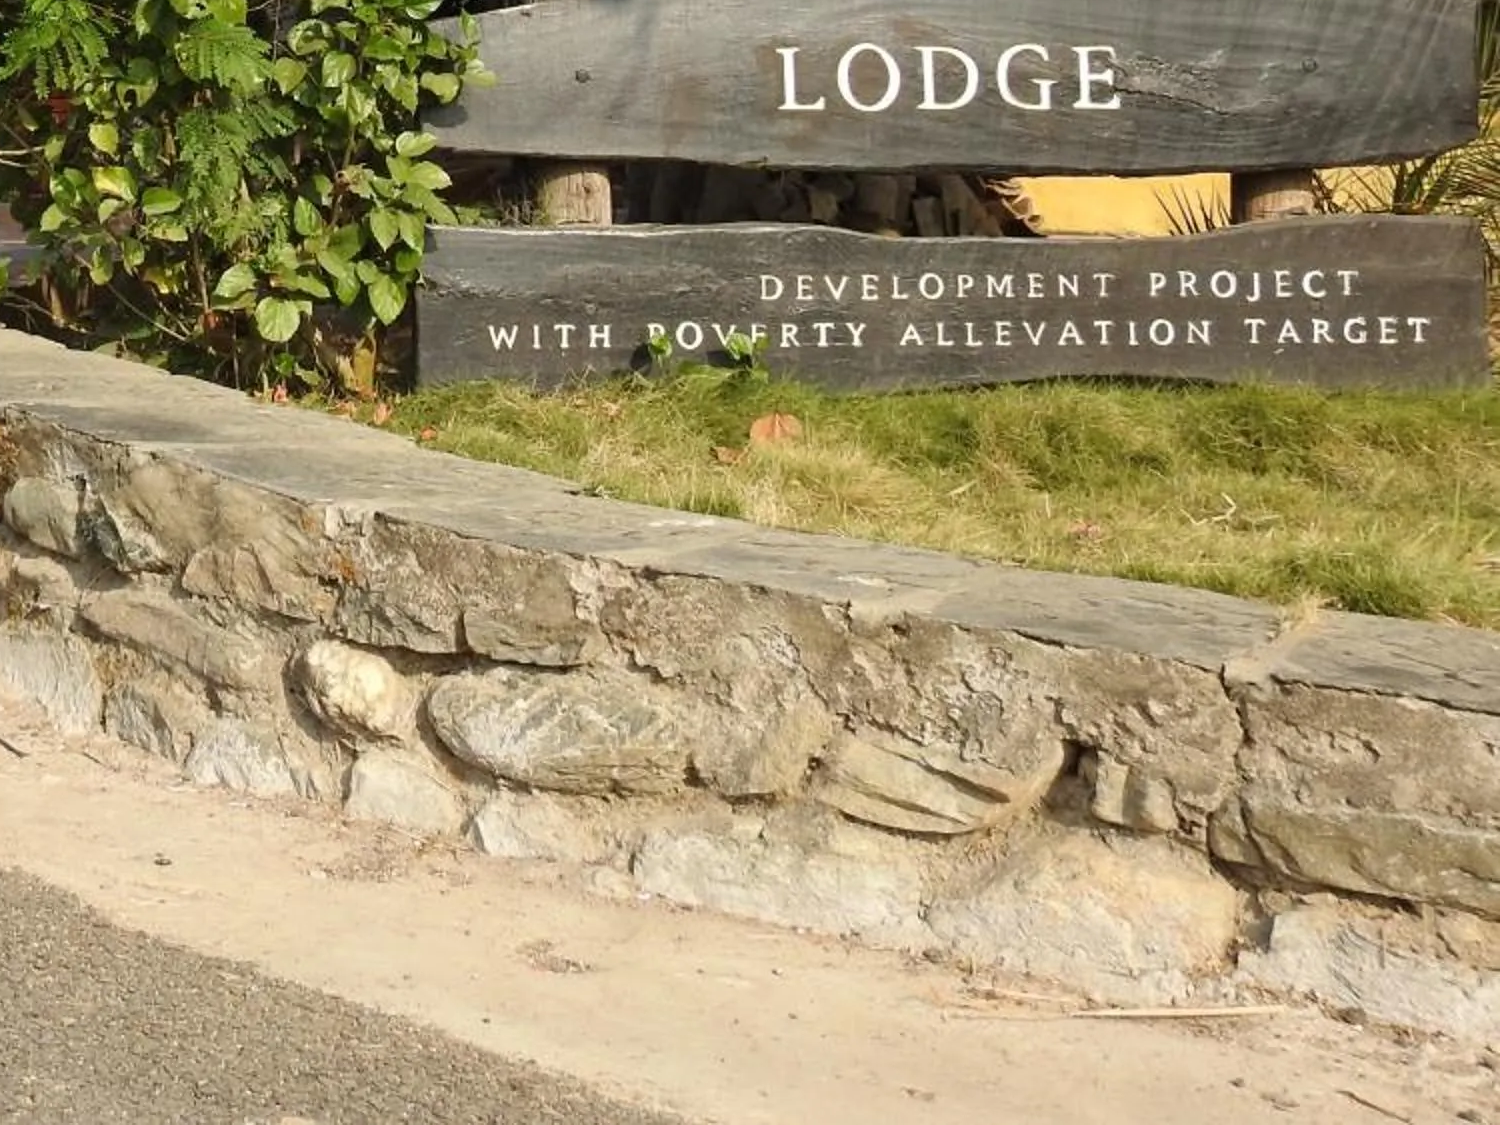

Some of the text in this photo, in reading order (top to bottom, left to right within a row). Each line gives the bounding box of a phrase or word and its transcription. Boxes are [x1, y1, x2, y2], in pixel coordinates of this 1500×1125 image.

[775, 41, 1124, 113] LODGE
[758, 268, 1361, 303] DEVELOPMENT PROJECT
[486, 322, 613, 350] WITH
[896, 319, 1213, 348] ALLEVATION
[1242, 315, 1433, 346] TARGET
